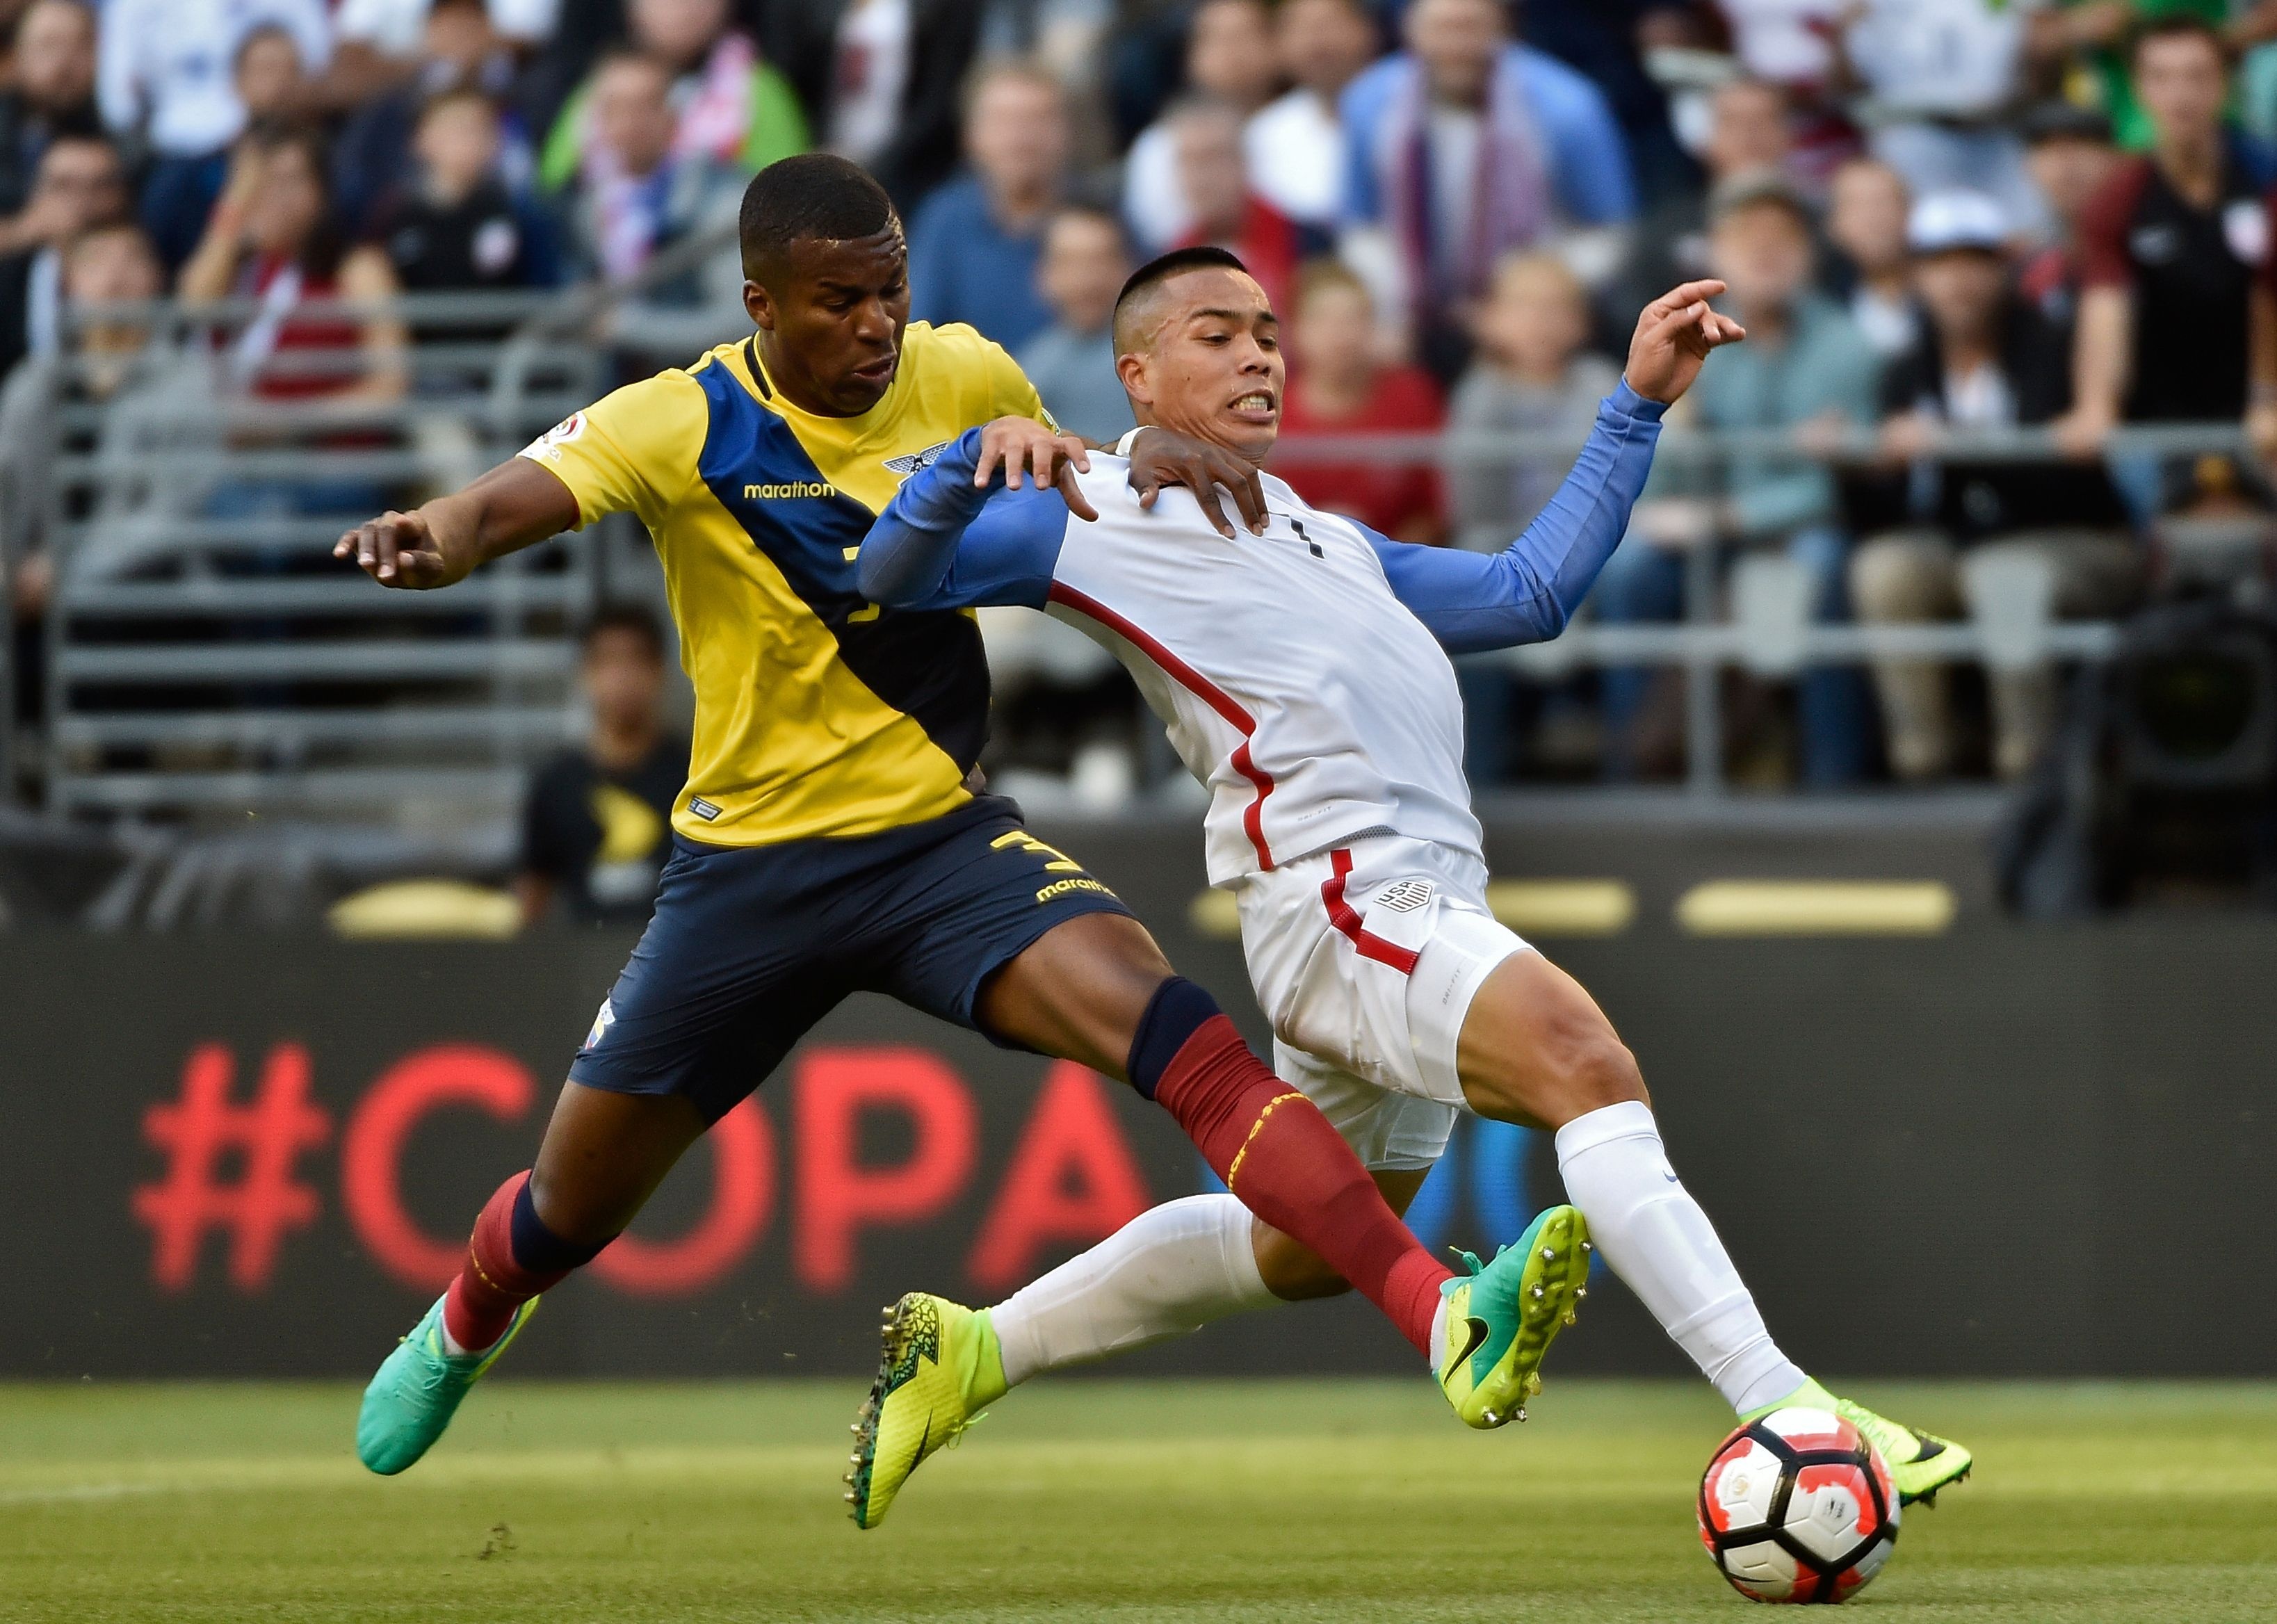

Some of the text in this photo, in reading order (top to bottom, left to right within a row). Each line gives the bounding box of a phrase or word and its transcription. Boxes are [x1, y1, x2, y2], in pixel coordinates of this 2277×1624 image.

[744, 480, 835, 498] marathon
[990, 831, 1084, 872] 3
[1378, 882, 1413, 902] USA
